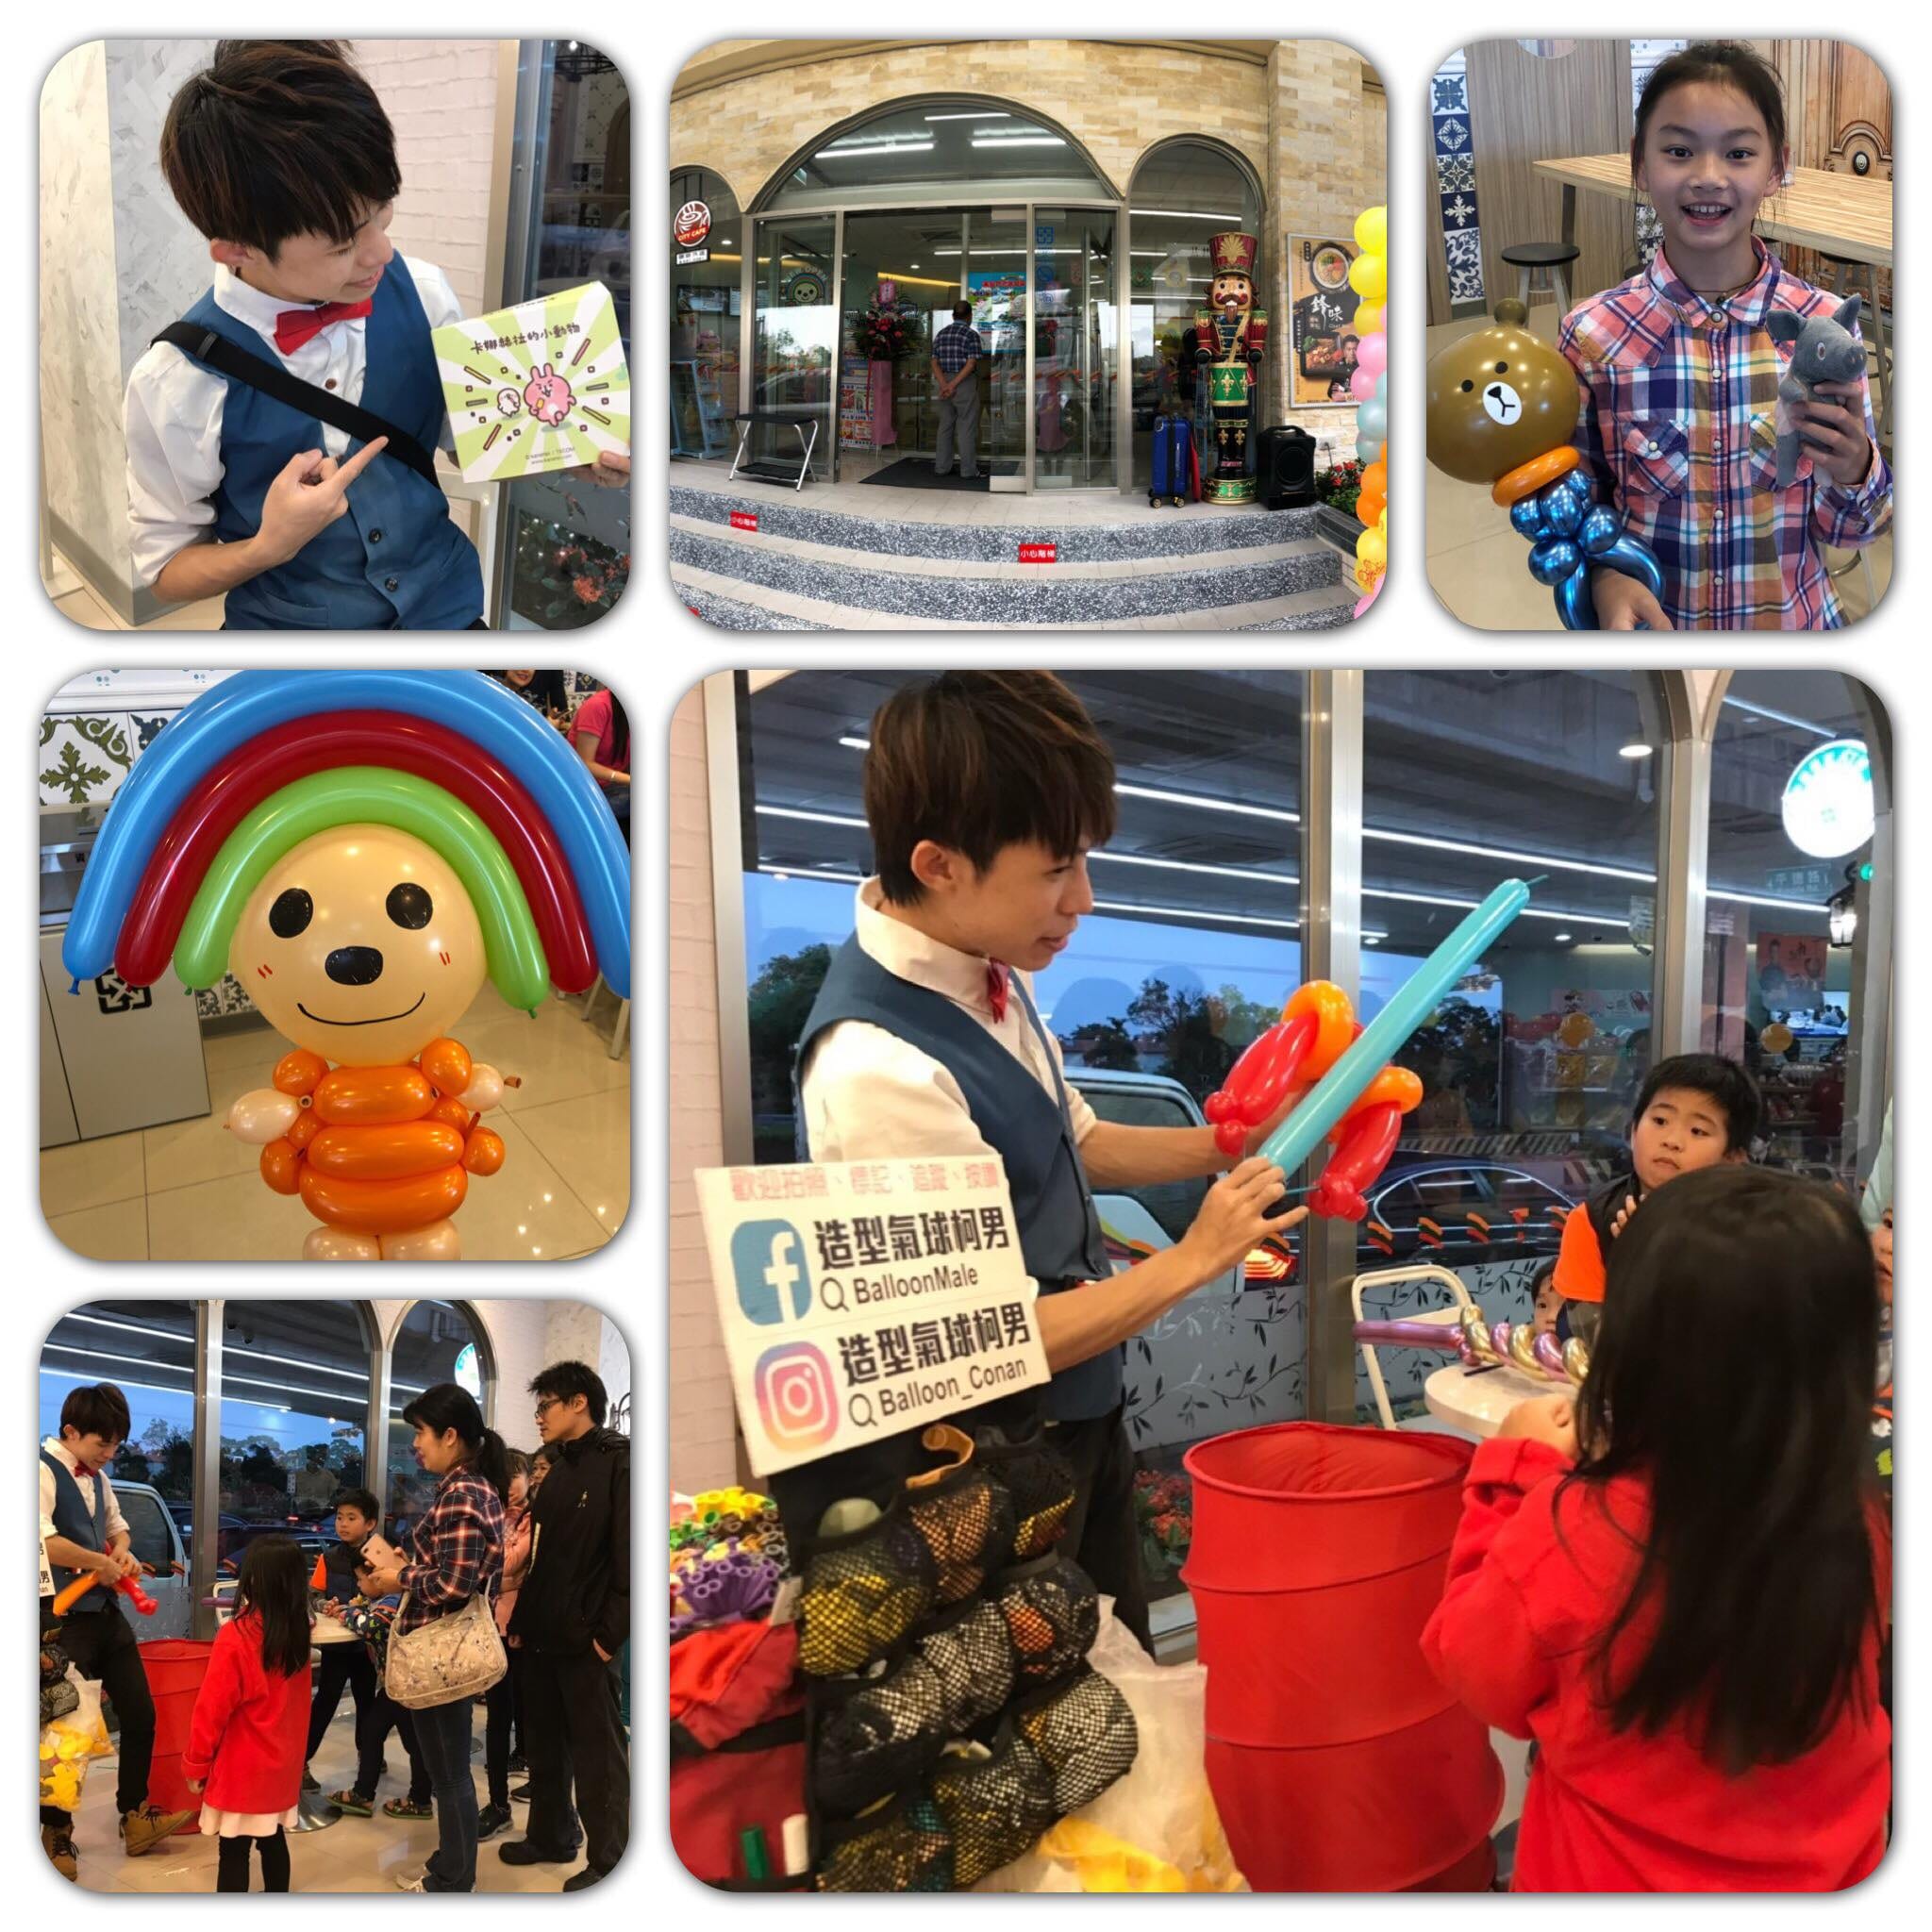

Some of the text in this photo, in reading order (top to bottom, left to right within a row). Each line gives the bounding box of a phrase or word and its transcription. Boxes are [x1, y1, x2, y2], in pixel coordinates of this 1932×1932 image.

[470, 322, 581, 355] 卡娜赫拉的小動物
[814, 1207, 1009, 1271] 造型氣球柯男
[853, 1264, 978, 1305] BalloonMale
[838, 1302, 1030, 1387] 造型氣球柯男
[878, 1358, 1027, 1416] Balloon_Conan
